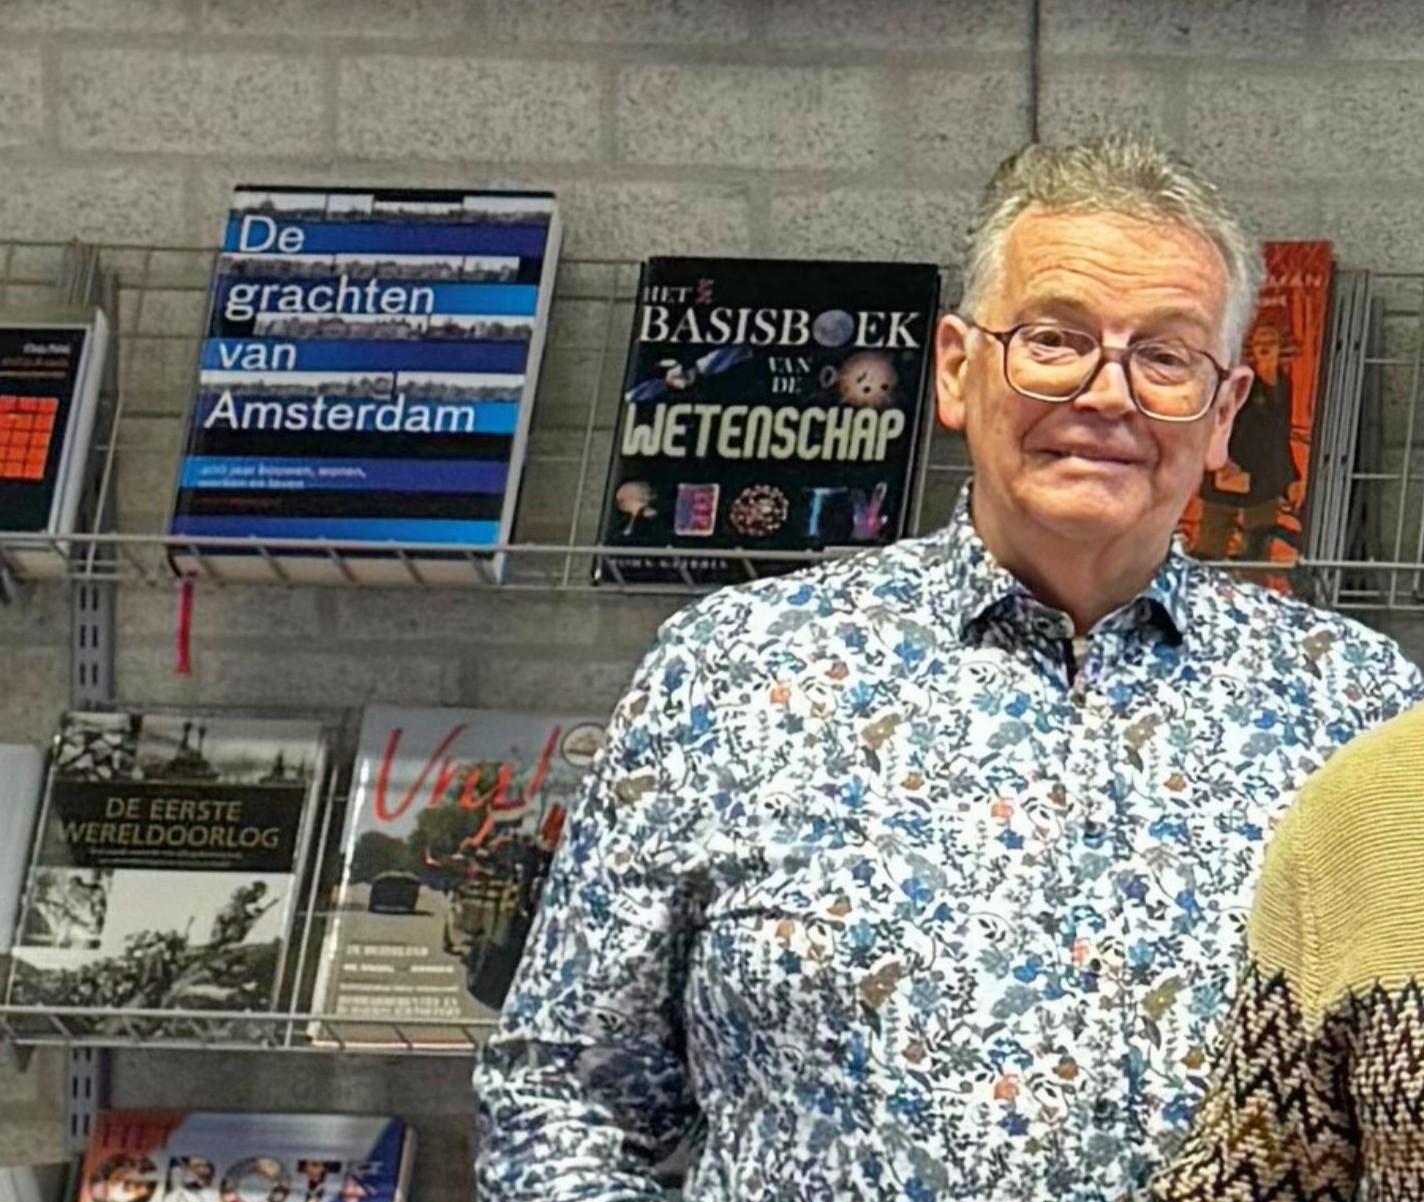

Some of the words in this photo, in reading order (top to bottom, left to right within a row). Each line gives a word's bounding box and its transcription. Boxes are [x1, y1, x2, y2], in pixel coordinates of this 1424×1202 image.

[238, 214, 305, 254] De
[225, 276, 435, 320] grachten
[643, 286, 693, 303] HET
[218, 341, 297, 370] van
[768, 355, 813, 374] VAN
[771, 377, 802, 394] DE
[204, 391, 475, 433] Amsterdam
[621, 403, 906, 461] WETENSCHAP
[104, 797, 141, 819] DE
[149, 798, 243, 821] EERSTE
[60, 819, 281, 849] WERELDOORLOG
